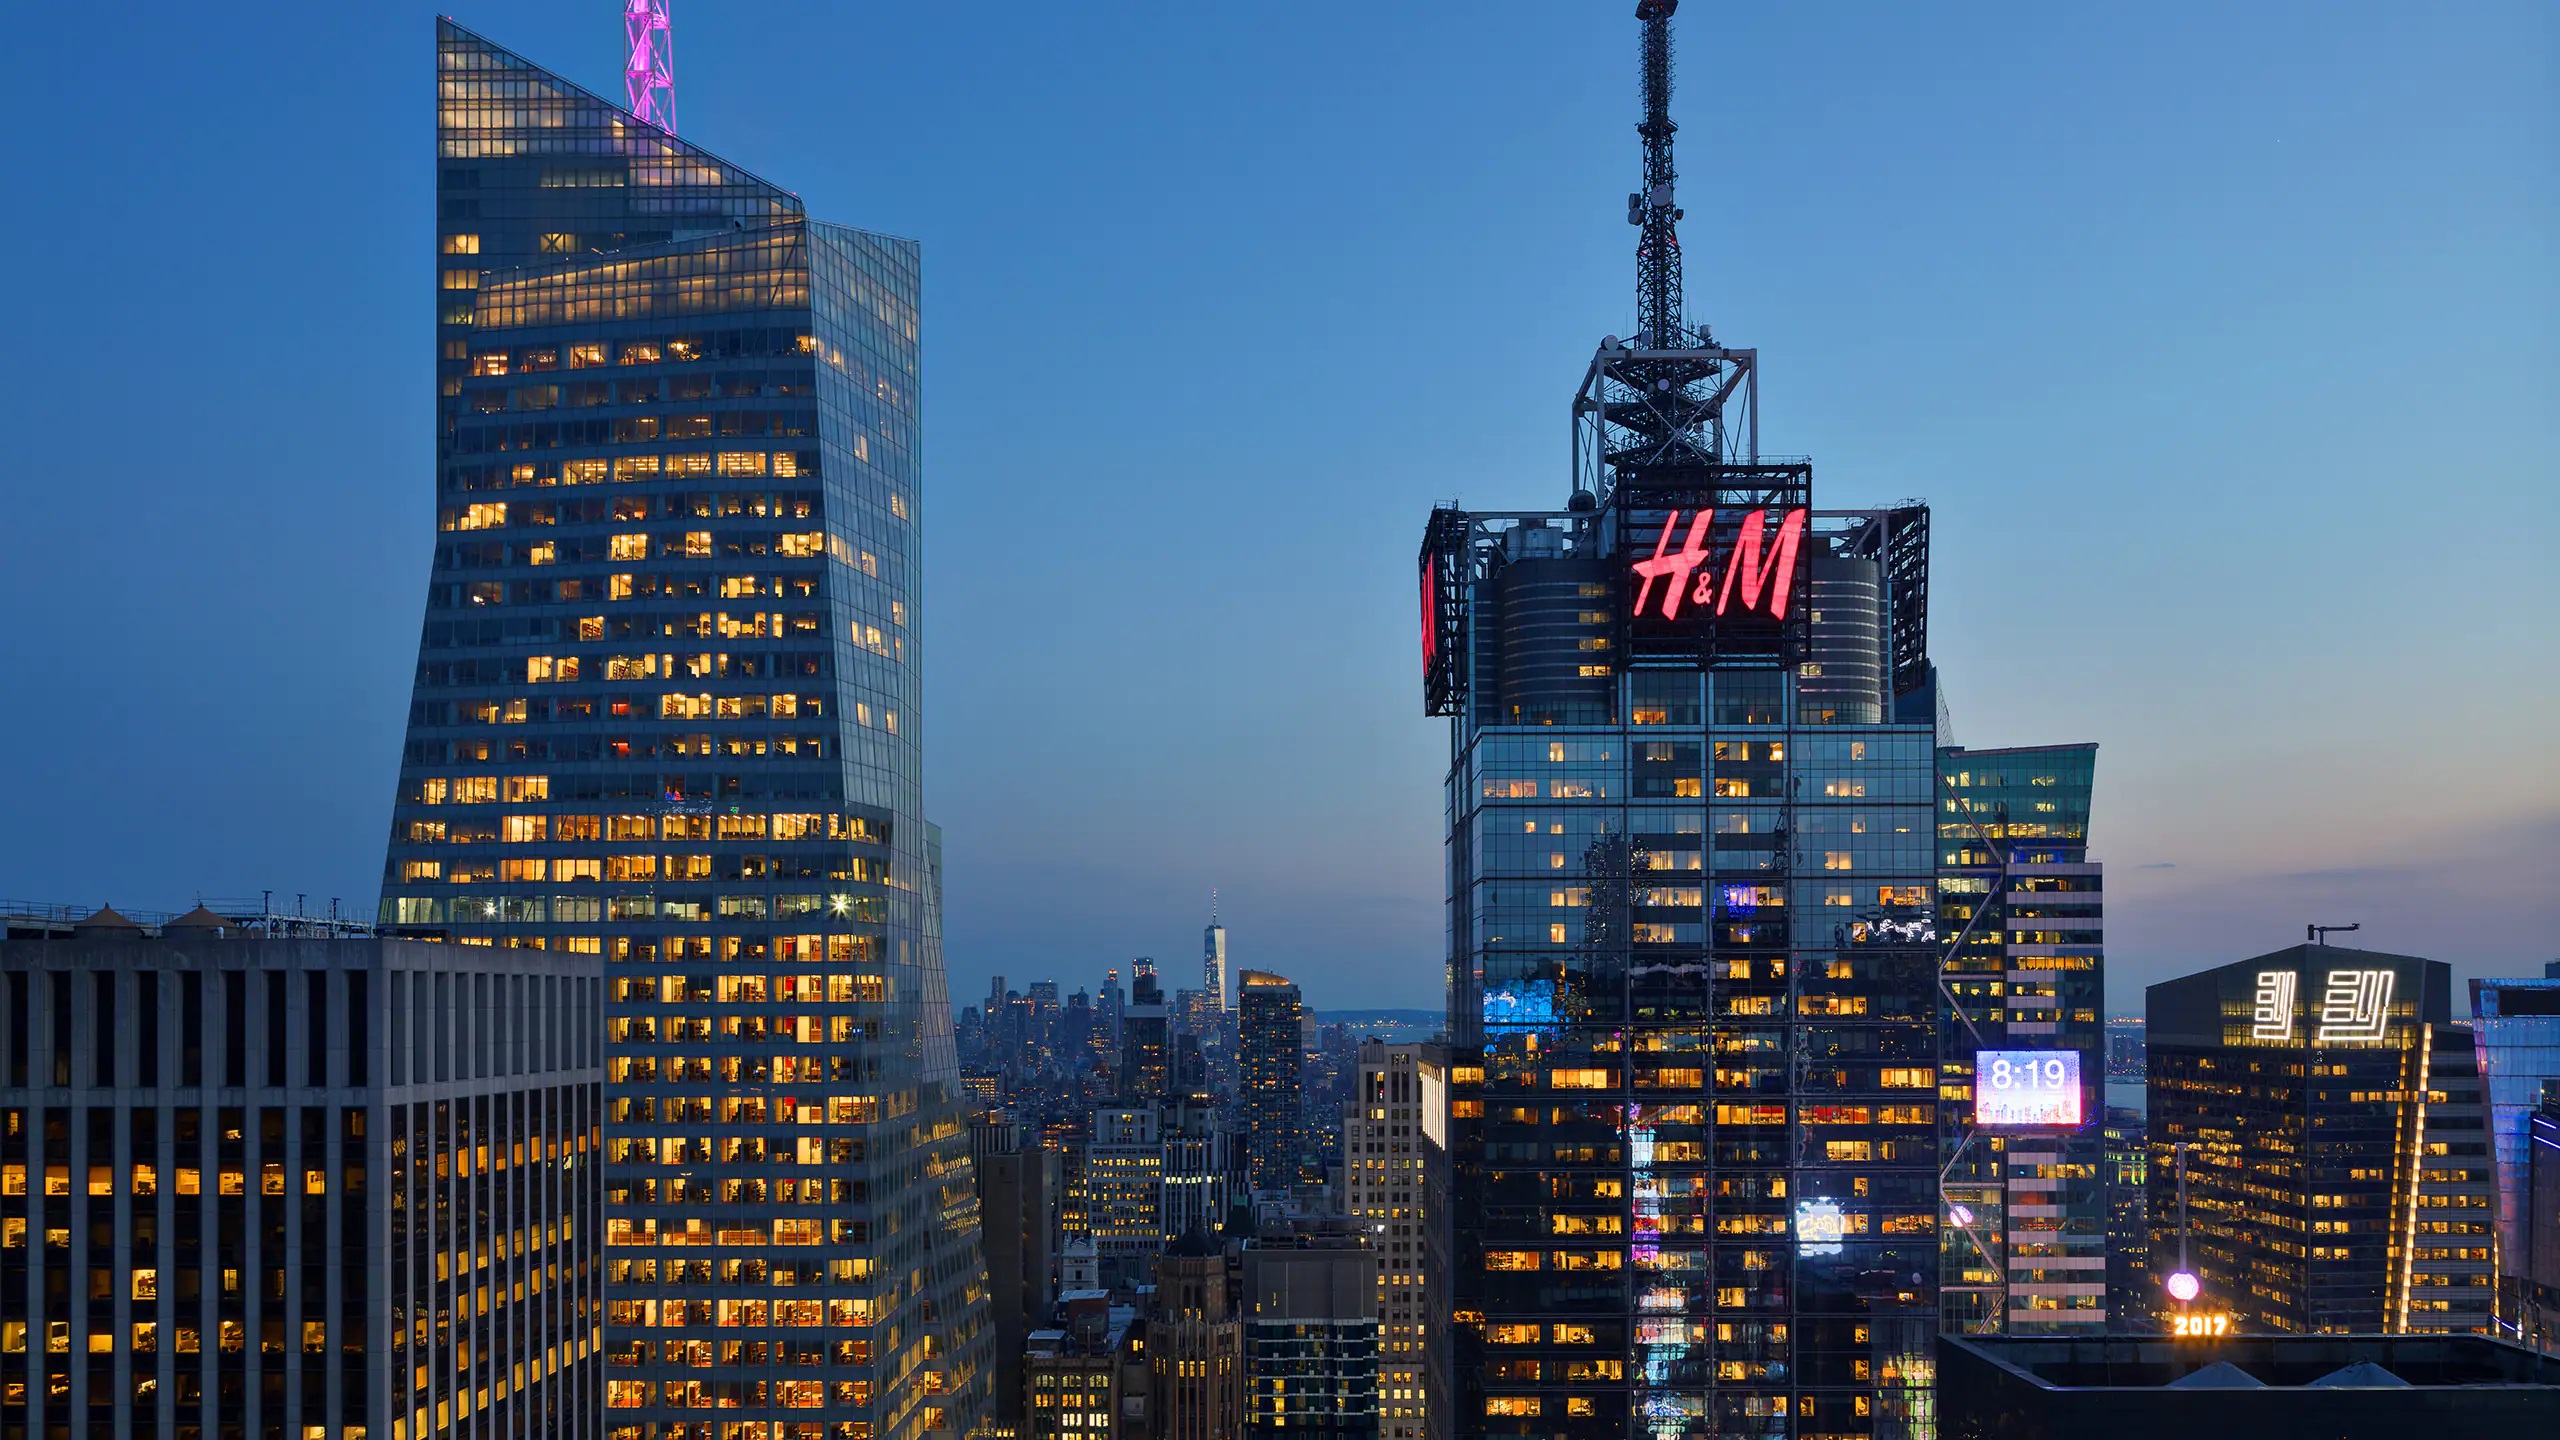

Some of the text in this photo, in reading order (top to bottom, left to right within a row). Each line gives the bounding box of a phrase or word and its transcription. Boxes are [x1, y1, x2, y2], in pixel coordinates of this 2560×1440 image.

[1632, 508, 1806, 621] H&M
[1992, 1059, 2065, 1089] 8:19
[2174, 1315, 2227, 1335] 2017
